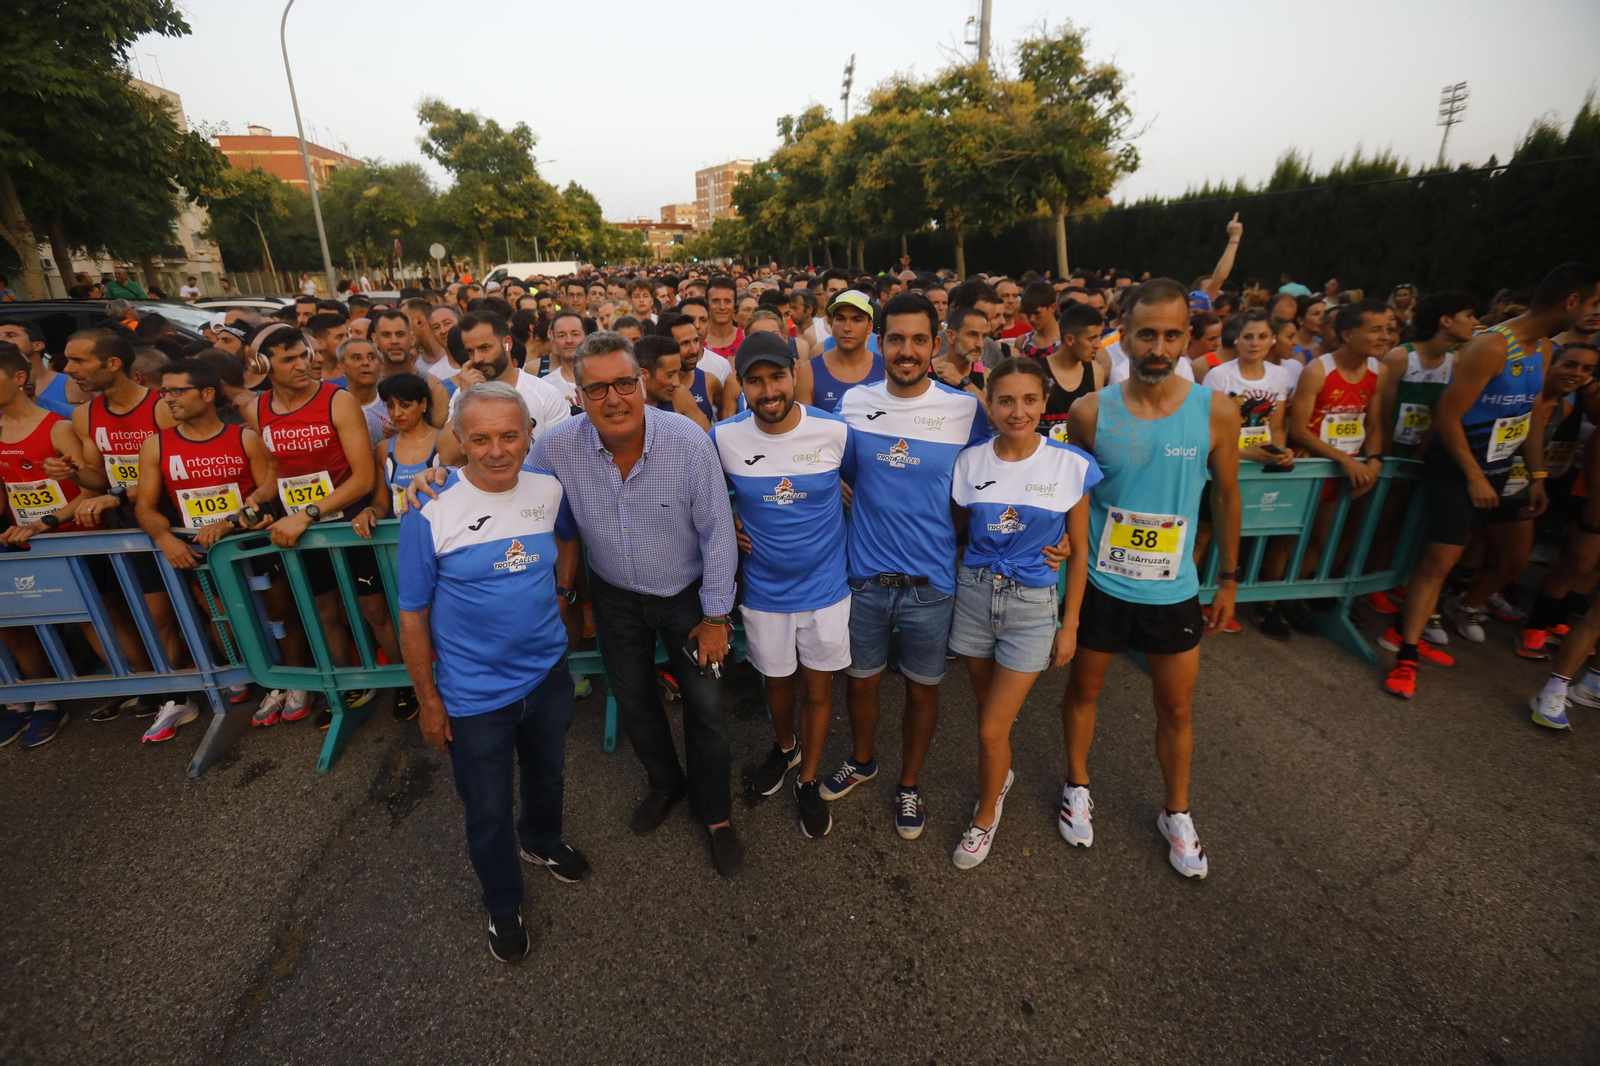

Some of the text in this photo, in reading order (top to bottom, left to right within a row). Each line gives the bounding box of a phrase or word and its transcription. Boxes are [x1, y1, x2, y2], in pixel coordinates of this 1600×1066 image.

[1336, 423, 1357, 435] 669
[1164, 444, 1197, 457] Salud
[118, 466, 138, 479] 98
[13, 491, 54, 506] 1333
[288, 485, 326, 503] 1374
[195, 497, 229, 513] 103
[1131, 529, 1158, 548] 58
[1128, 554, 1171, 565] laArruzafa
